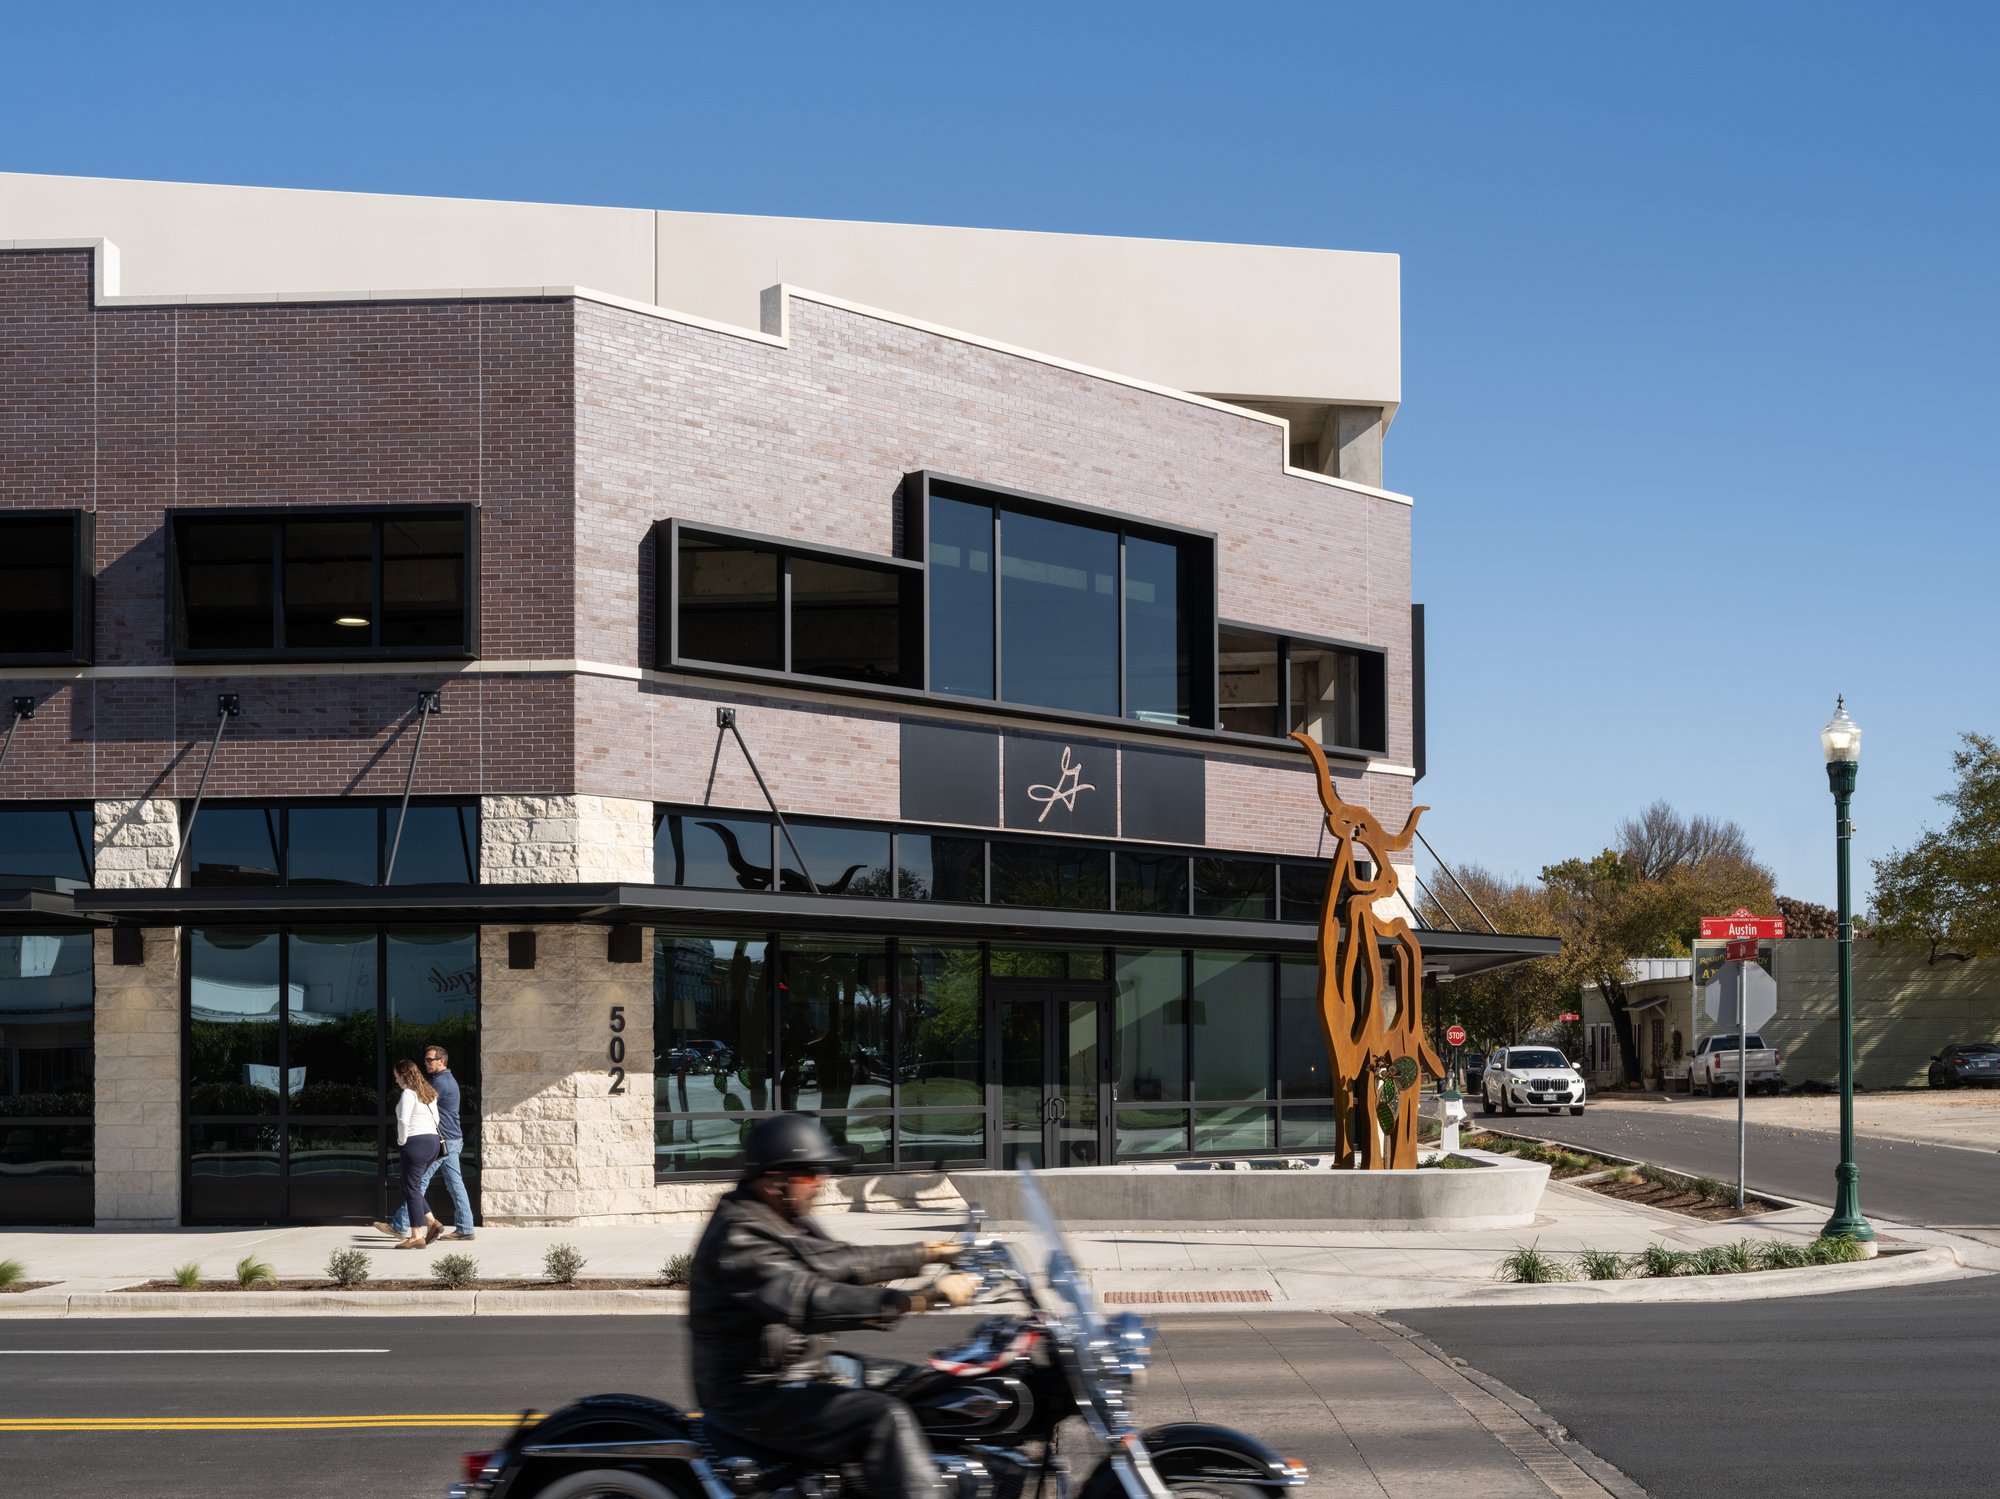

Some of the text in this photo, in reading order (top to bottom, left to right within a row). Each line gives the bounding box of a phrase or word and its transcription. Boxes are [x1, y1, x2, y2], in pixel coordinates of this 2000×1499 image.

[1728, 923, 1757, 935] Austin
[1448, 1031, 1464, 1040] STOP
[608, 1006, 626, 1096] 502
